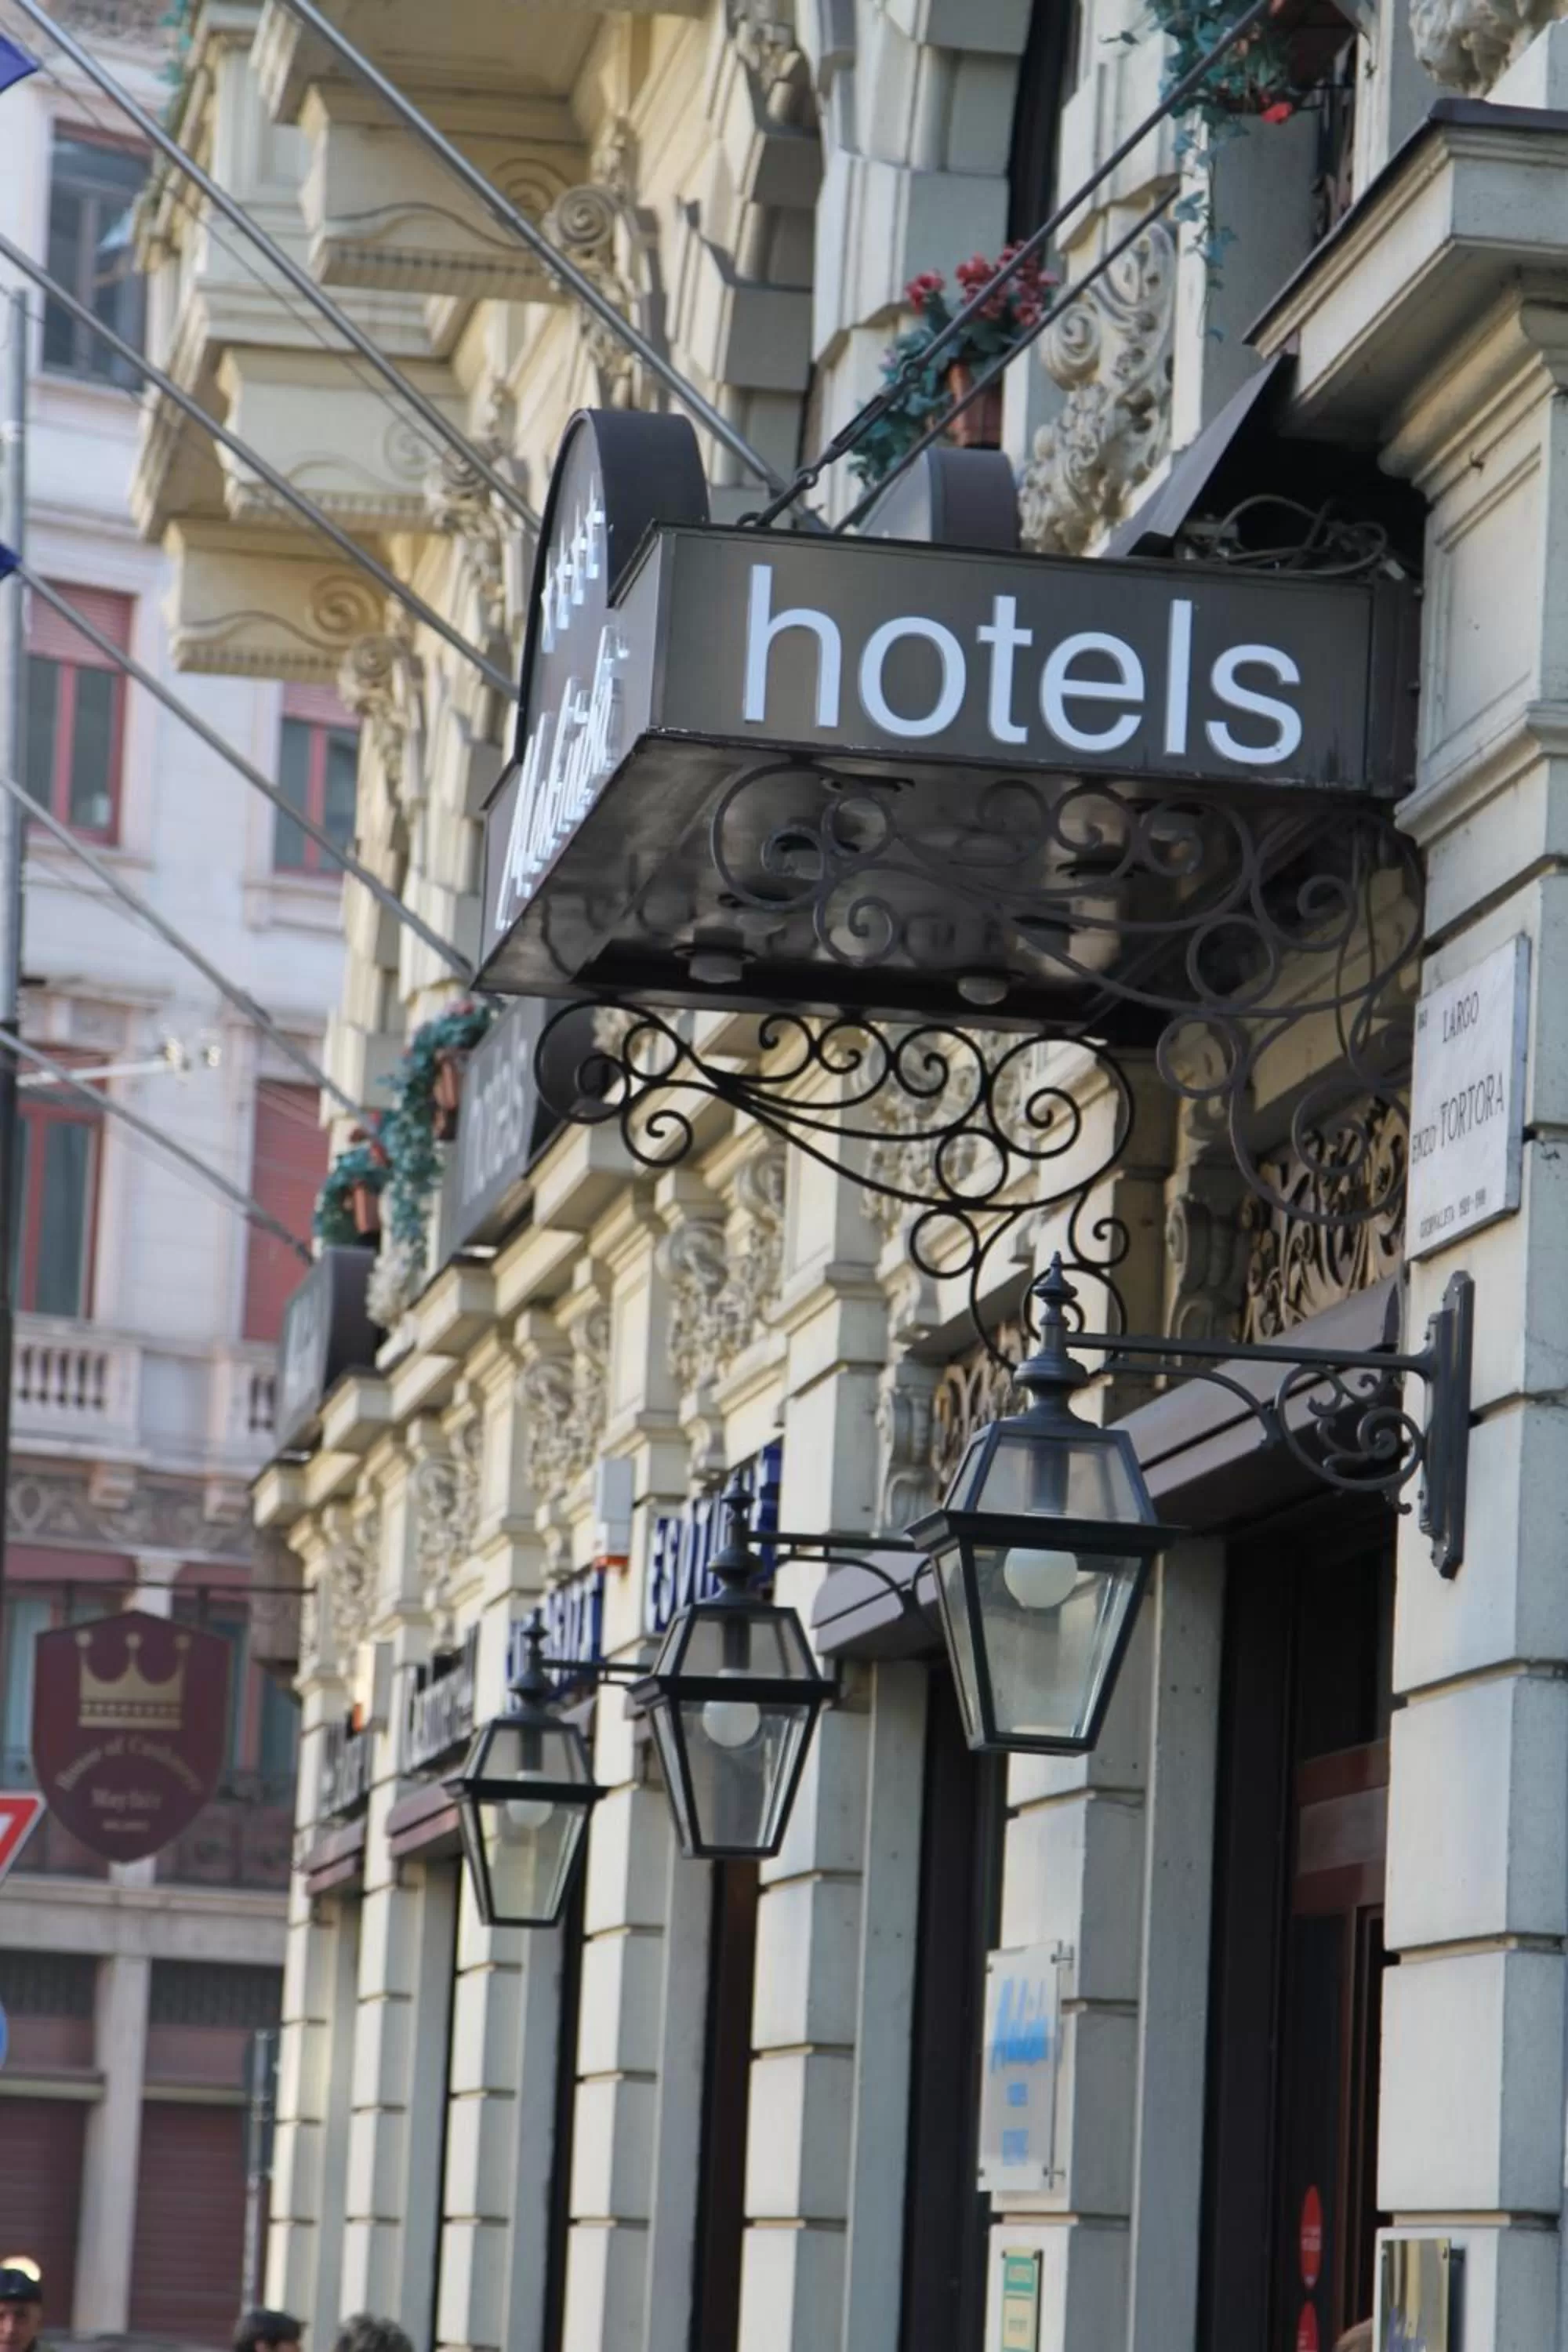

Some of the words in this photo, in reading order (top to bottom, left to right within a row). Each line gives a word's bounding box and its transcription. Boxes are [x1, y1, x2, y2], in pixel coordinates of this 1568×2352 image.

[743, 564, 1303, 765] hotels
[1443, 990, 1479, 1044] LARGO
[1411, 1124, 1436, 1165] ENZO
[1440, 1071, 1504, 1149] TORTORA
